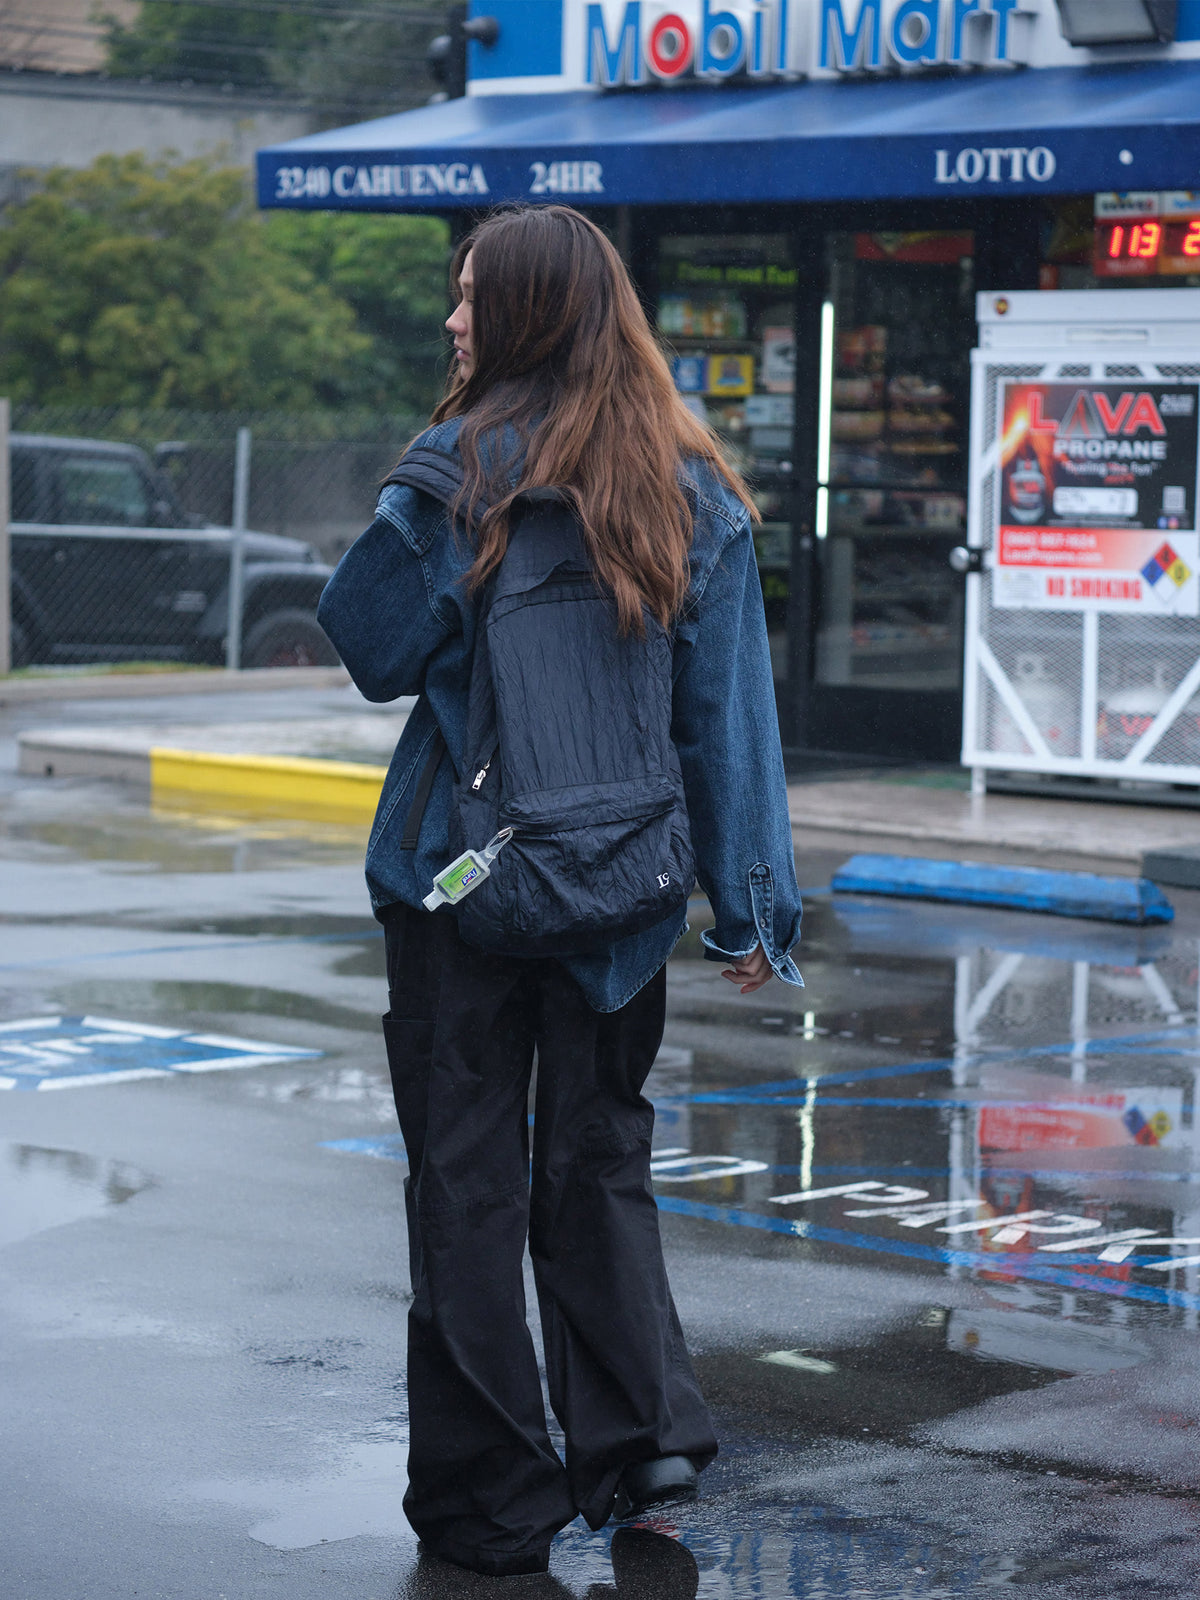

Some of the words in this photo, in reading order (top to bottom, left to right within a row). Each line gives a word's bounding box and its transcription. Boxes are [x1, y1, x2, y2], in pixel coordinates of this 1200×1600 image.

[585, 0, 790, 84] Mobil
[816, 0, 1030, 72] Mart
[275, 167, 331, 199] 3240
[332, 163, 490, 197] CAHUENGA
[528, 161, 605, 193] 24HR
[934, 146, 1057, 183] LOTTO
[1109, 223, 1161, 258] 113
[1053, 439, 1167, 460] PROPANE
[1071, 577, 1142, 600] SMOKING
[650, 1148, 769, 1184] O
